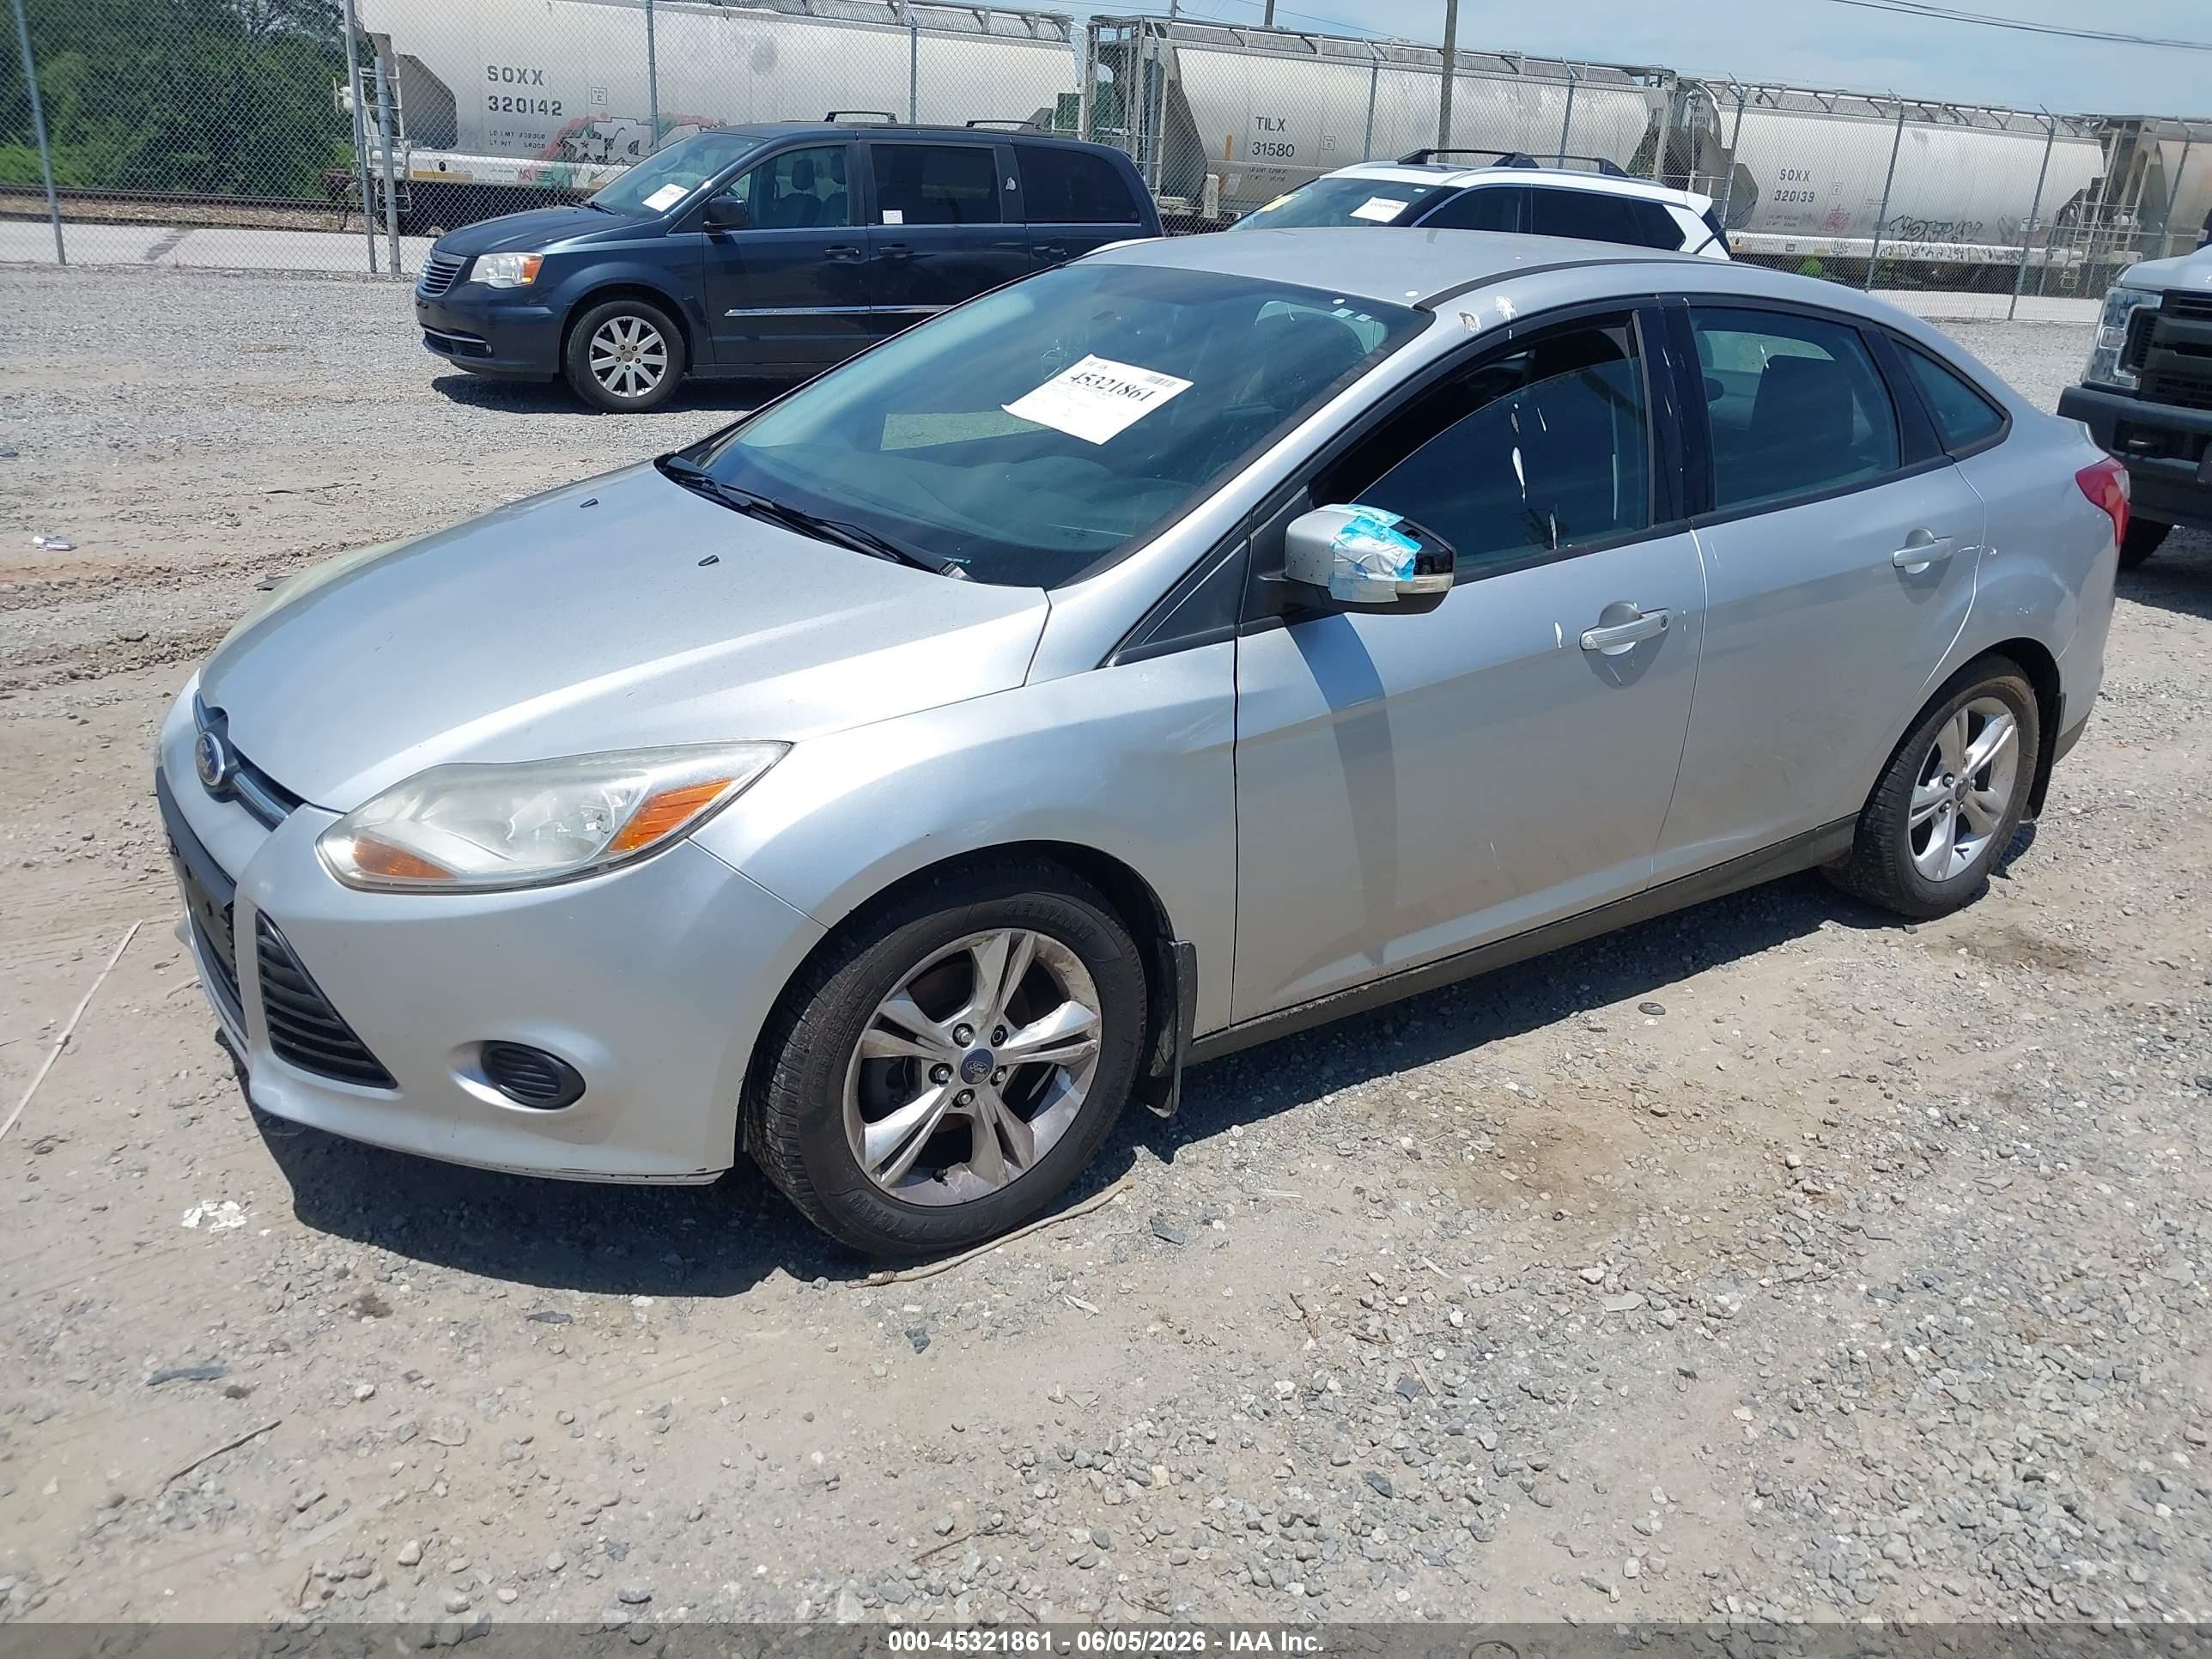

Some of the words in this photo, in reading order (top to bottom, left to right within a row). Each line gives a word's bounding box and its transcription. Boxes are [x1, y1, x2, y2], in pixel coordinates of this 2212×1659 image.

[487, 65, 544, 86] SOXX
[488, 94, 562, 117] 320142
[1255, 116, 1286, 132] TILX
[1251, 141, 1295, 157] 31580
[1778, 168, 1811, 182] SOXX
[1774, 190, 1815, 203] 320139
[1069, 372, 1157, 402] 45321861
[969, 1061, 988, 1073] Ford
